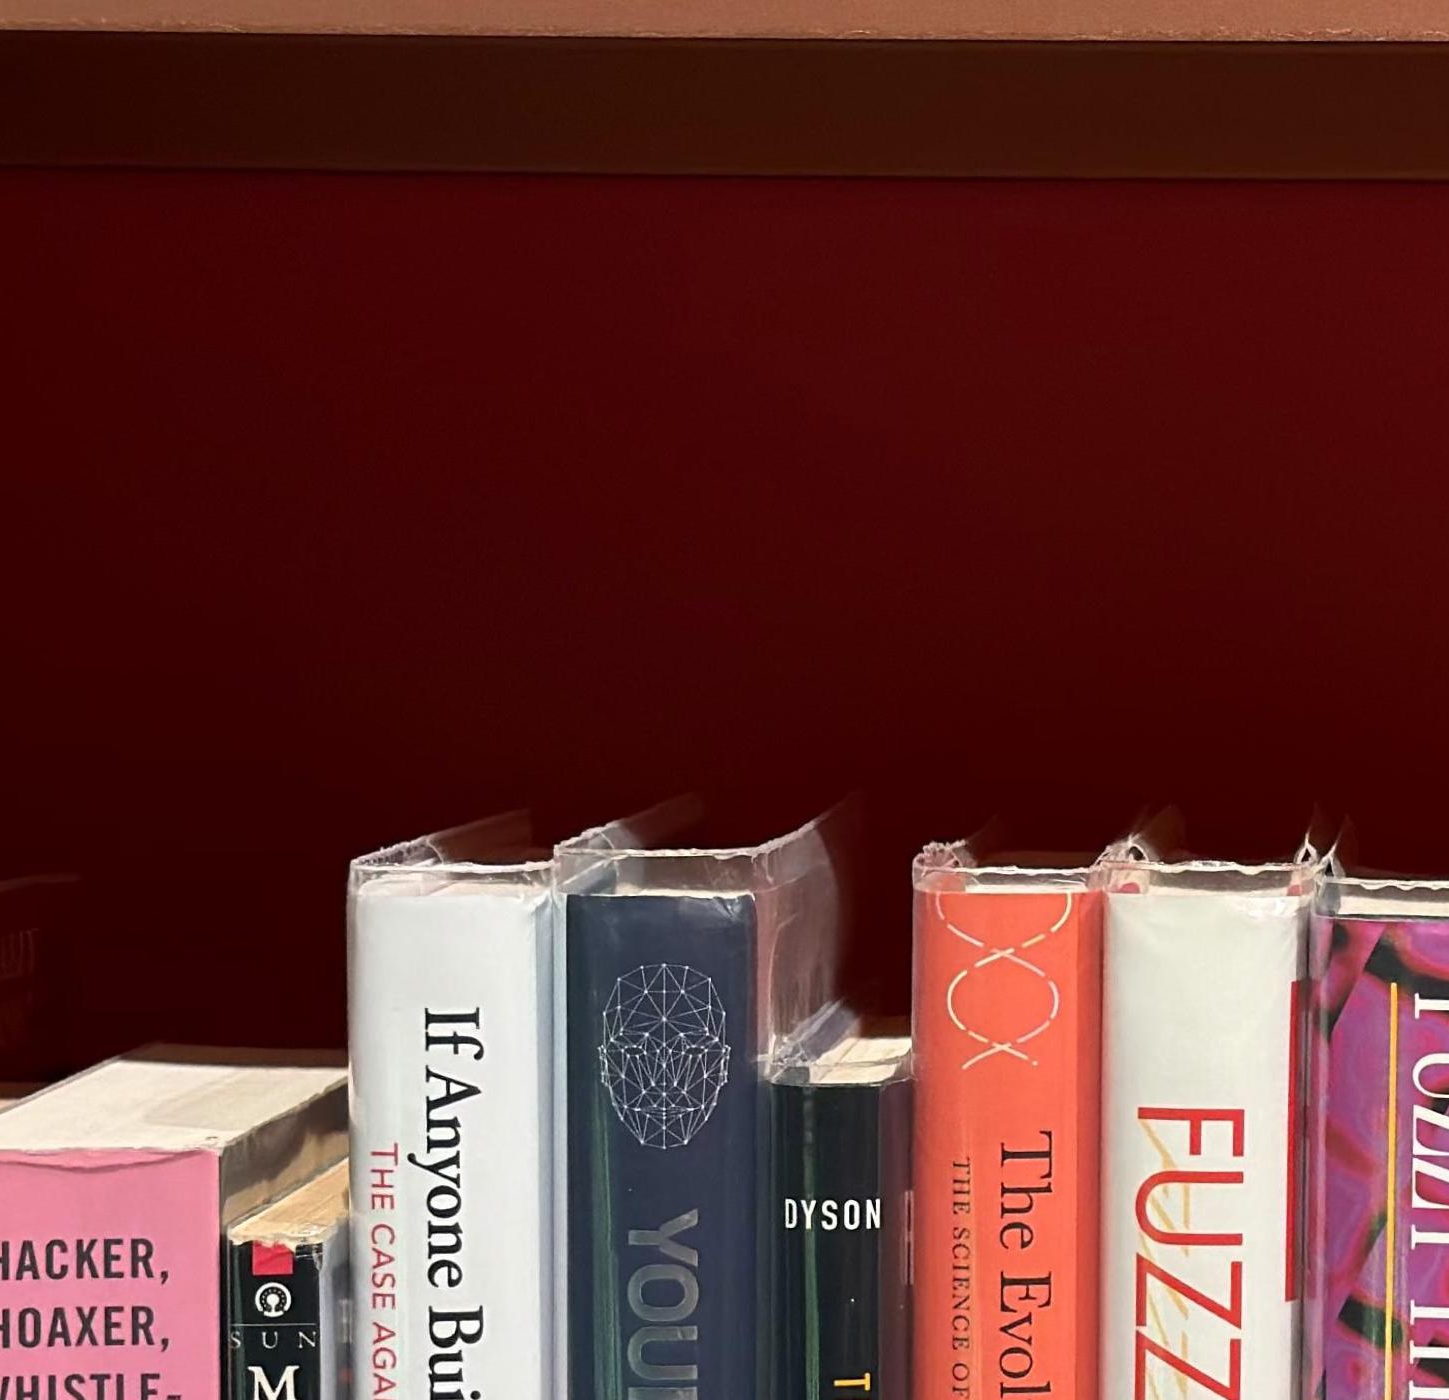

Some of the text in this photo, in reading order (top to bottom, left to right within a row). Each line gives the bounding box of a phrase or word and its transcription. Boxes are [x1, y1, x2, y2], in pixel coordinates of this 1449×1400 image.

[425, 1008, 484, 1060] If
[371, 1143, 398, 1210] THE
[407, 1065, 481, 1287] Anyone
[953, 1157, 970, 1214] THE
[1000, 1131, 1052, 1249] The
[784, 1199, 881, 1230] DYSON
[371, 1224, 395, 1309] CASE
[952, 1227, 969, 1350] SCIENCE
[952, 1363, 969, 1392] OF
